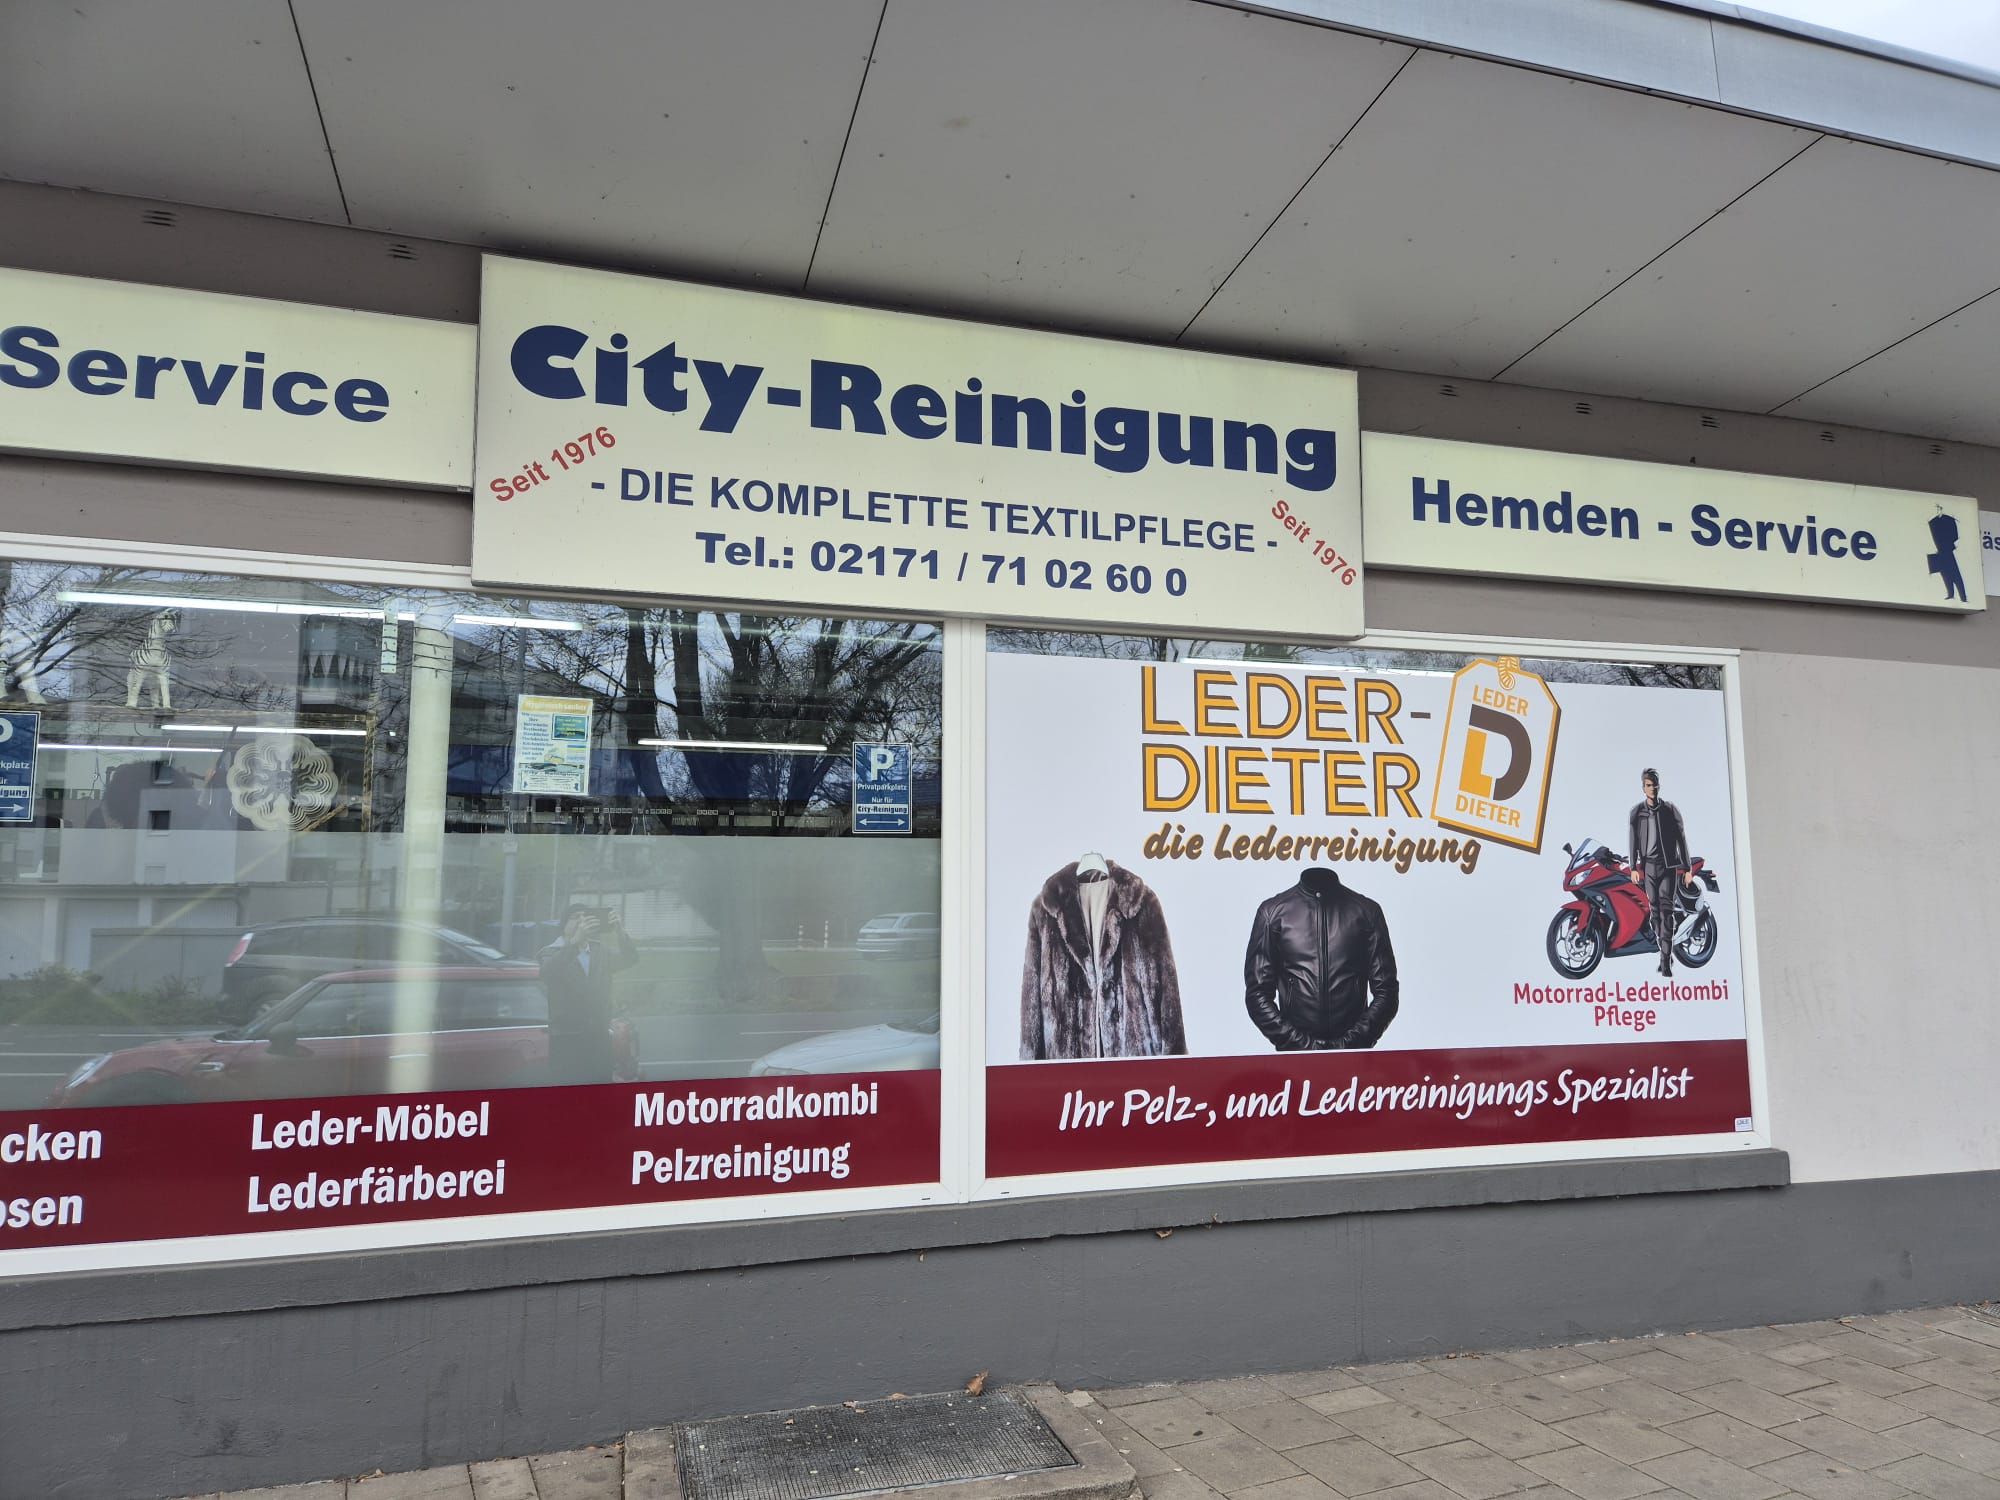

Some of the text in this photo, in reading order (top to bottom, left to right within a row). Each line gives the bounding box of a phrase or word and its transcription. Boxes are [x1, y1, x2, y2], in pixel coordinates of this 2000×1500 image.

[0, 325, 390, 423] Service
[510, 325, 1336, 491] City-Reinigung
[489, 426, 617, 502] Seit 1976
[620, 468, 694, 506] DIE
[711, 476, 969, 529] KOMPLETTE
[982, 501, 1255, 553] TEXTILPFLEGE
[1411, 476, 1640, 540] Hemden
[1691, 503, 1878, 561] Service
[696, 531, 1187, 597] Tel.: 02171 / 71 02 60 0
[1271, 499, 1357, 586] Seit 1976
[1141, 665, 1431, 745] LEDER-
[1472, 684, 1529, 717] LEDER
[857, 783, 908, 791] Privatparkplatz
[870, 748, 895, 781] P
[1142, 743, 1423, 819] DIETER
[857, 805, 908, 814] City-Reinigung
[884, 796, 894, 804] für
[1455, 794, 1521, 828] DIETER
[1143, 822, 1482, 875] die Lederreinigung
[1513, 979, 1729, 1004] Motorrad-Lederkombi
[1594, 1005, 1657, 1032] Pflege
[634, 1082, 878, 1127] Motorradkombi
[1059, 1066, 1695, 1131] Ihr Pelz-, und Lederreinigungs Spezialist
[0, 1123, 102, 1163] cken
[251, 1101, 490, 1151] Leder-Möbel
[247, 1159, 506, 1213] Lederfärberei
[631, 1142, 851, 1185] Pelzreinigung
